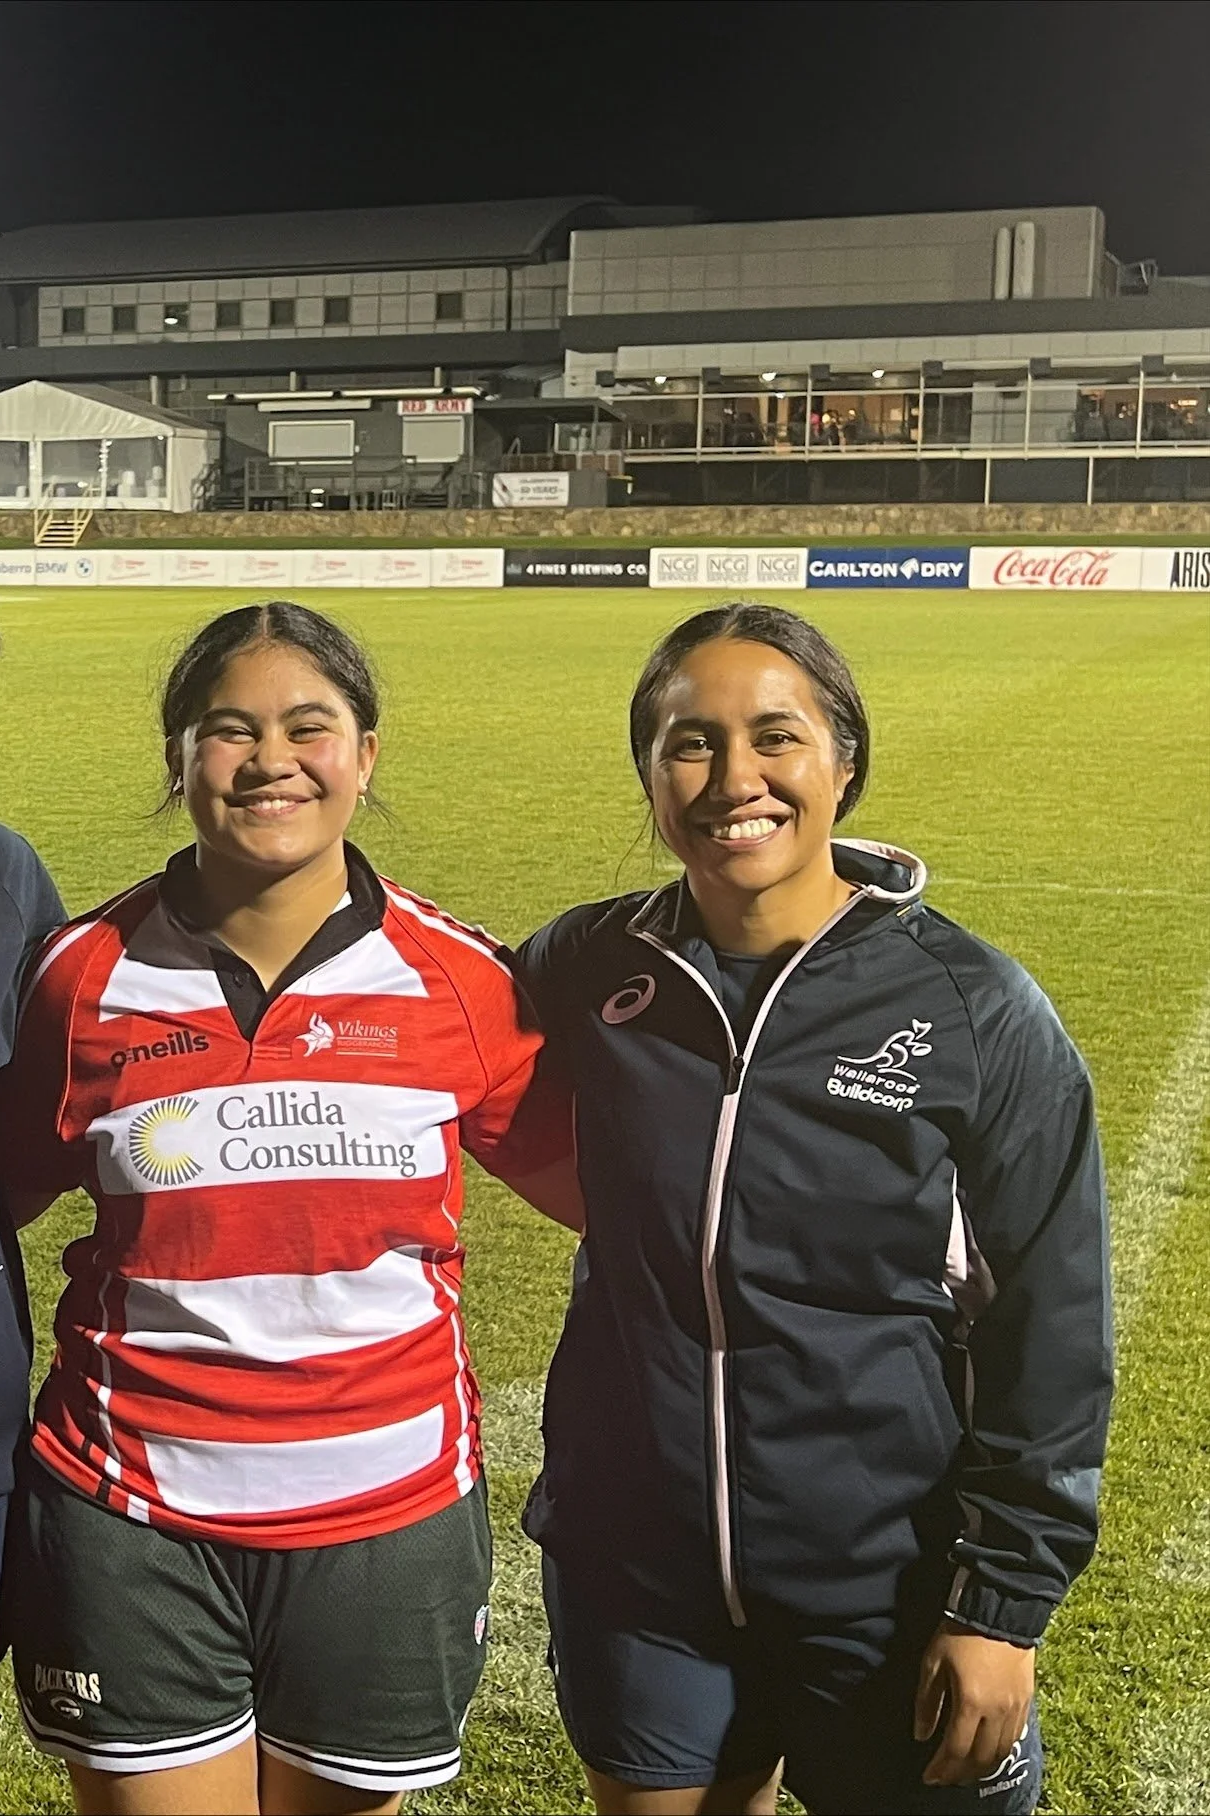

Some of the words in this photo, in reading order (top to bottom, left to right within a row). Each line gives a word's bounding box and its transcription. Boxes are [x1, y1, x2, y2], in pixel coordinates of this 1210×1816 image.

[401, 400, 427, 413] RED
[434, 399, 467, 413] ARMY
[35, 562, 68, 574] BMW
[525, 564, 534, 575] 4
[535, 563, 567, 576] PINES
[570, 563, 624, 576] BREWING
[661, 558, 695, 571] NCG
[709, 558, 745, 572] NCG
[761, 558, 795, 572] NCG
[809, 560, 899, 578] CARLTON
[920, 562, 964, 578] DRY
[1170, 551, 1210, 588] ARIS
[337, 1019, 399, 1040] Vikings
[833, 1063, 919, 1095] Wallaroos
[826, 1077, 914, 1113] Buildcorp
[216, 1090, 347, 1131] Callida
[219, 1131, 417, 1178] Consulting
